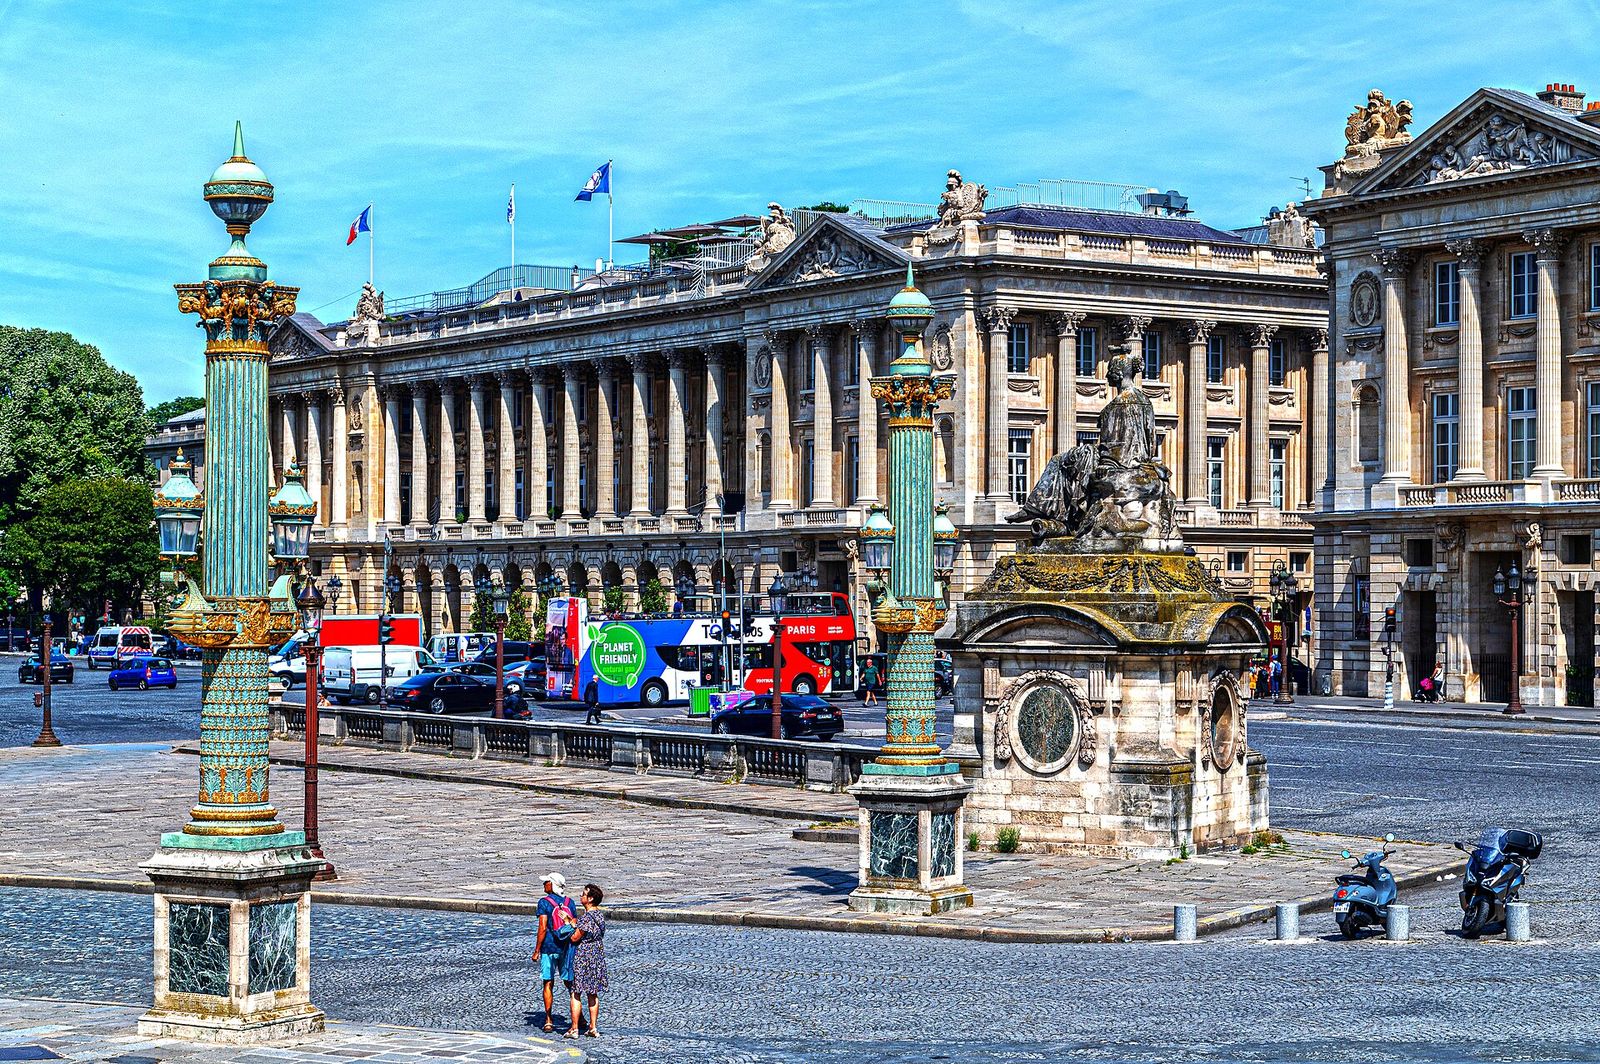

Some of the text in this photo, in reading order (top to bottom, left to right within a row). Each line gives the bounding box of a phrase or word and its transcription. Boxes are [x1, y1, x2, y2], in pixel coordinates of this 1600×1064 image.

[701, 624, 763, 639] TOUS
[787, 625, 816, 635] PARIS
[603, 642, 634, 653] PLANET
[599, 653, 638, 664] FRIENDLY
